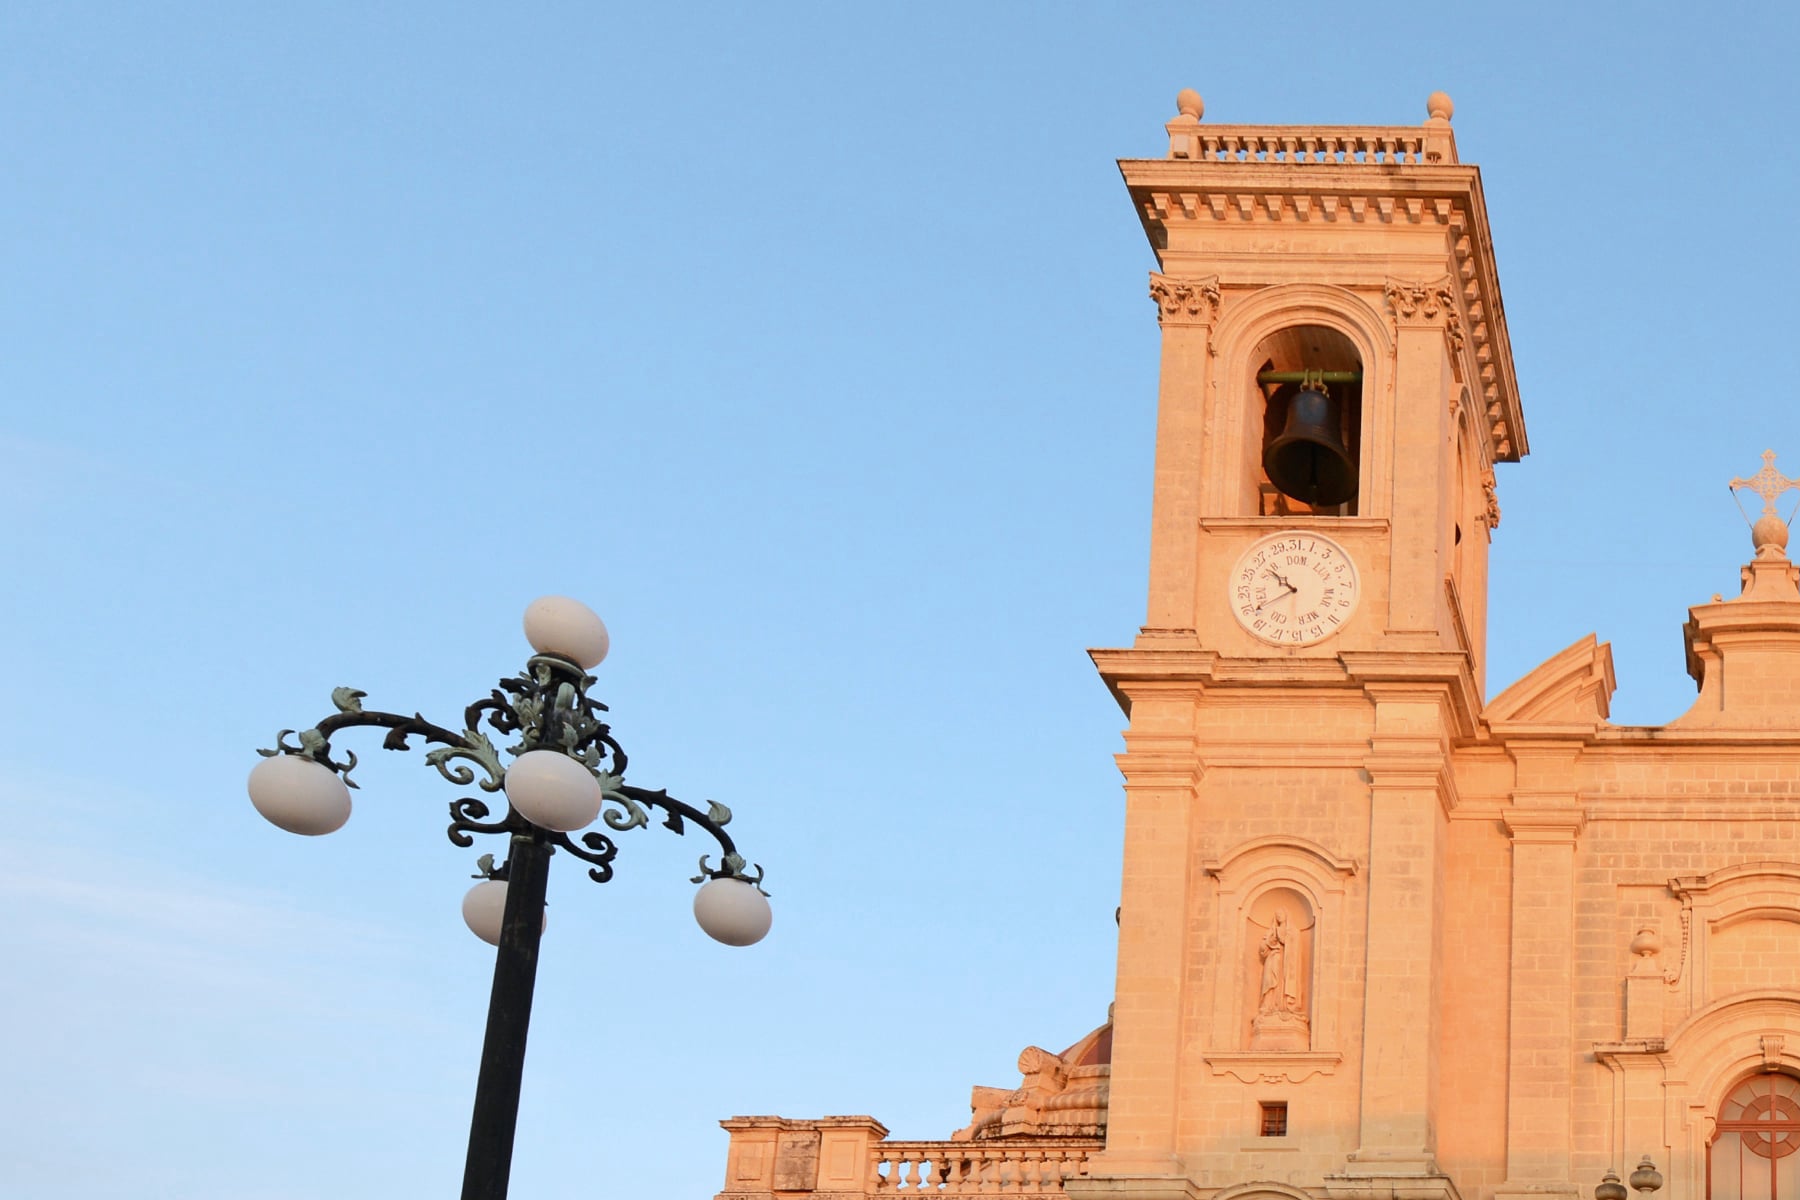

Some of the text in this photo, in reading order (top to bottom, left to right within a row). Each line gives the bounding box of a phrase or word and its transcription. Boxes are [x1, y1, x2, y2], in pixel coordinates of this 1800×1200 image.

[1271, 542, 1285, 555] 29
[1321, 548, 1333, 559] 3
[1253, 551, 1266, 567] 27
[1242, 567, 1255, 582] 25
[1334, 564, 1346, 573] 5
[1340, 581, 1352, 589] 7
[1238, 585, 1250, 599] 23
[1241, 603, 1255, 616] 21
[1253, 619, 1267, 632] 19
[1269, 629, 1283, 640] 17
[1291, 630, 1303, 641] 15
